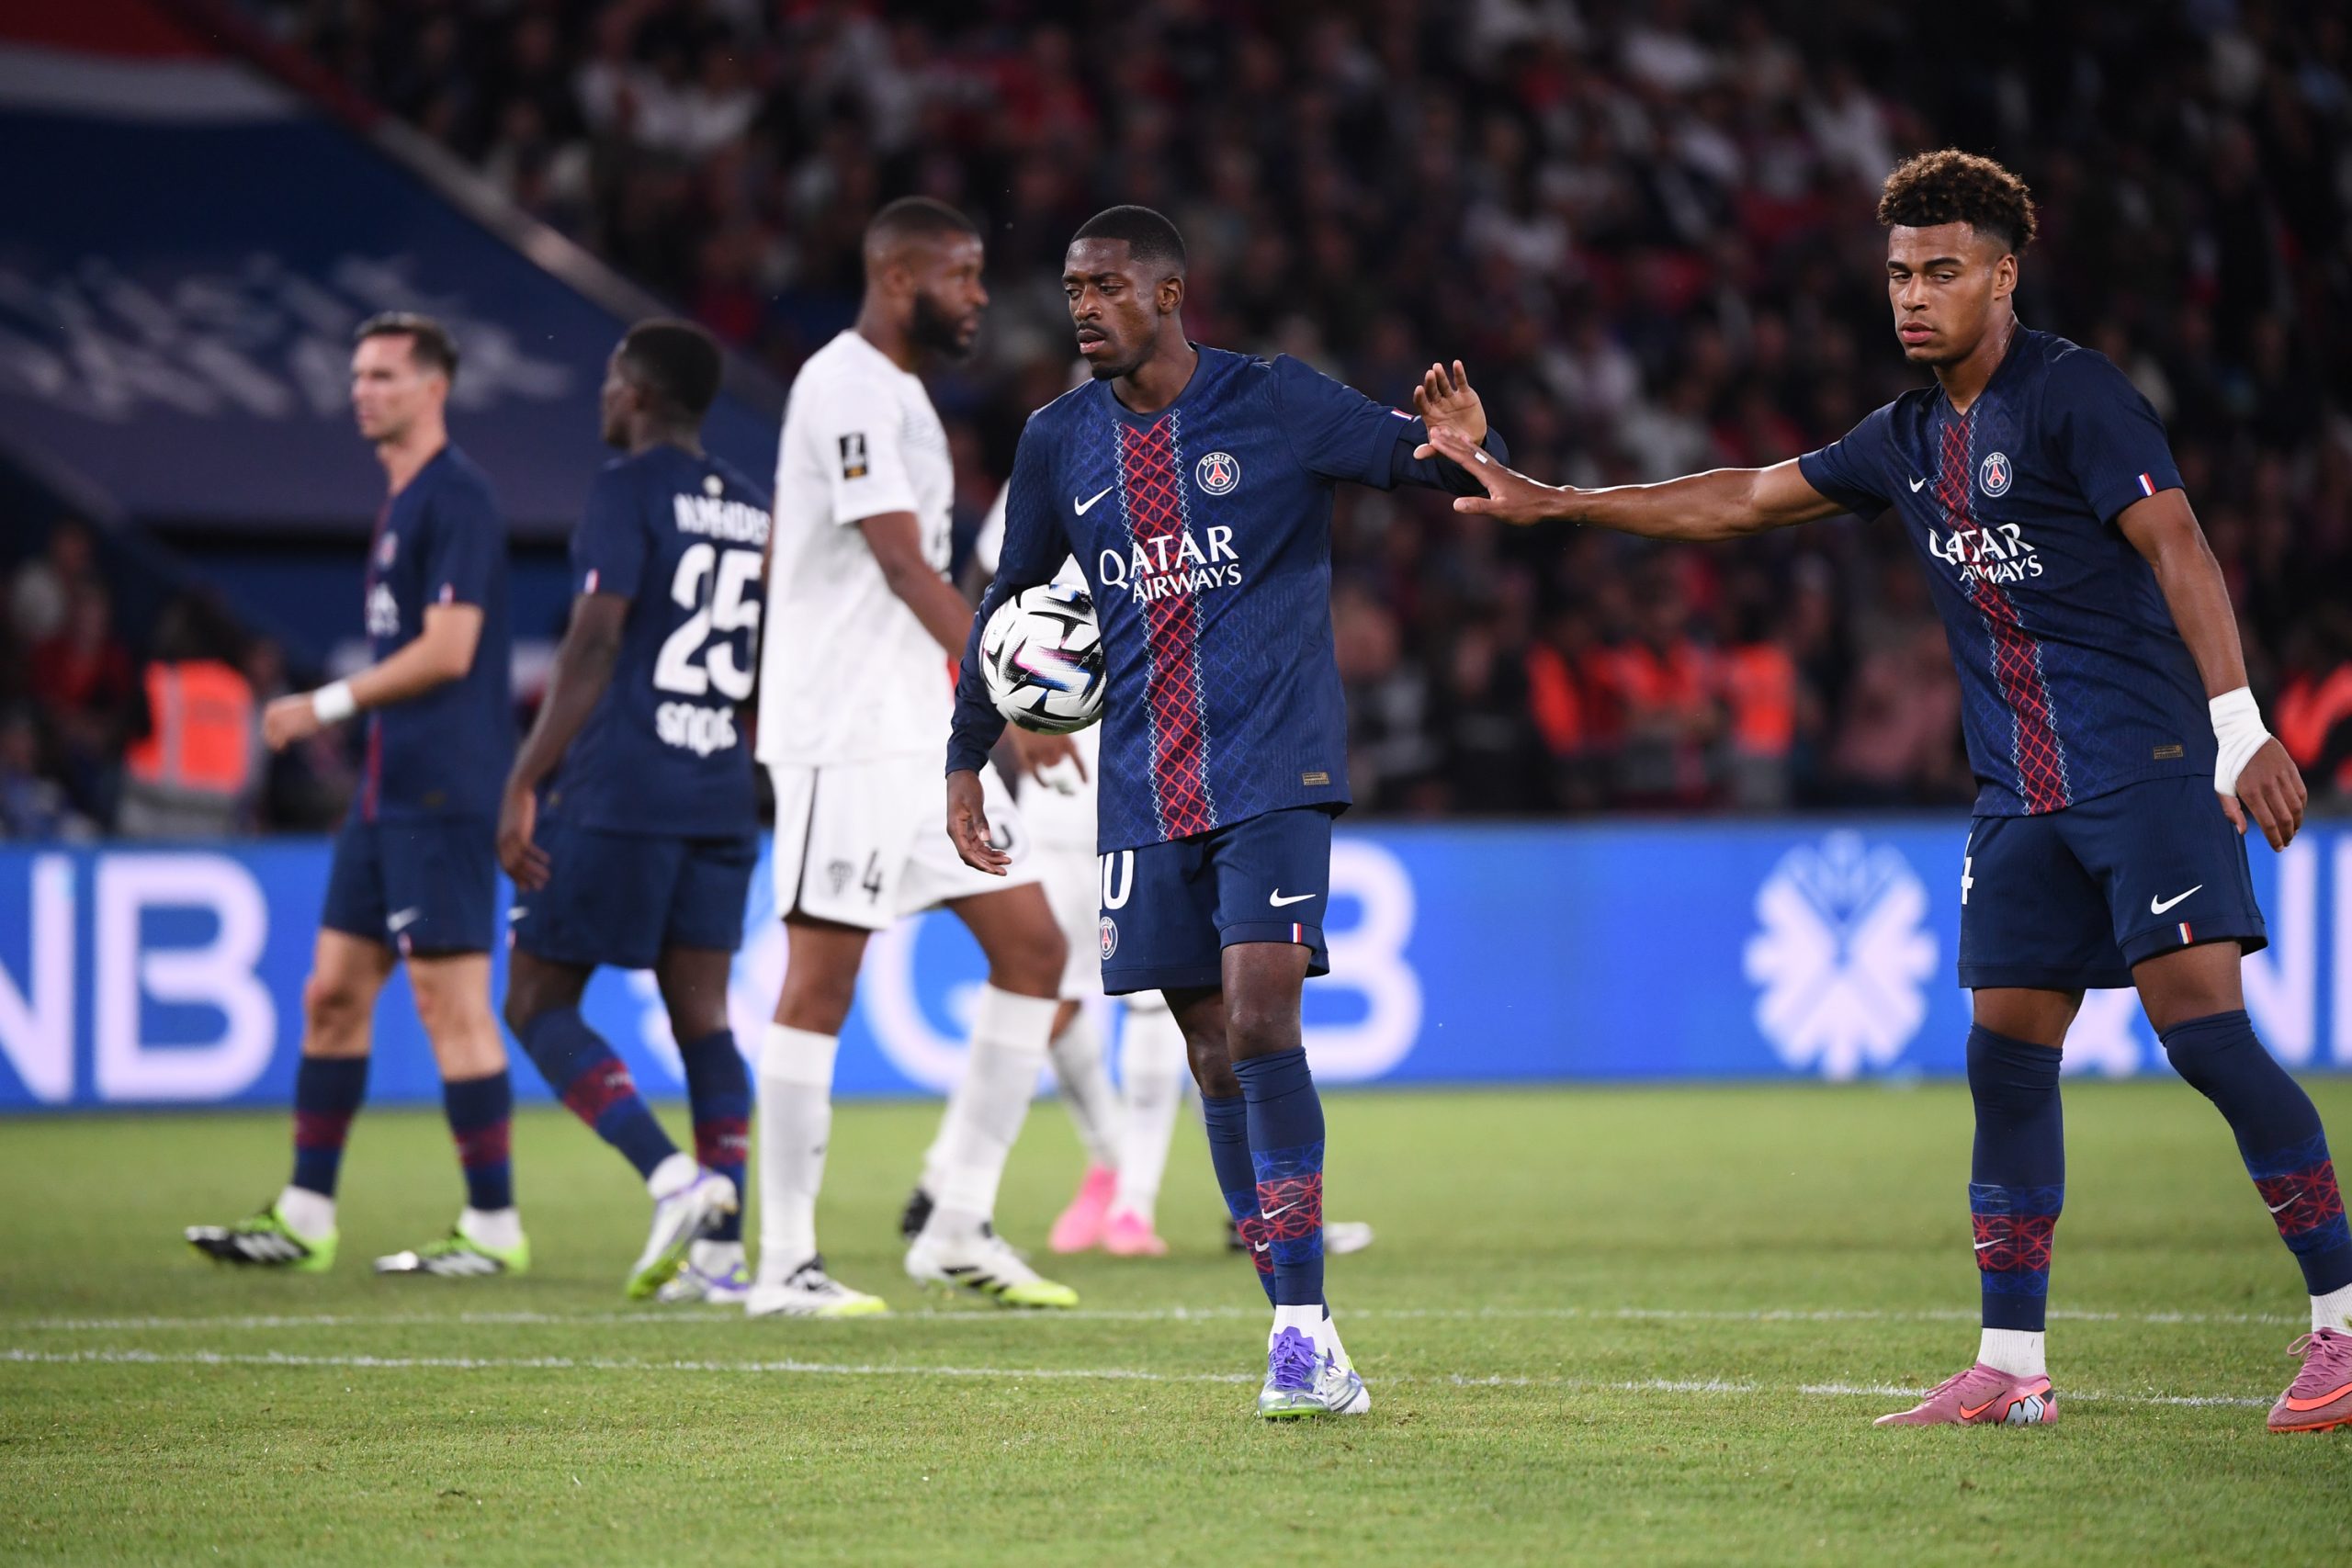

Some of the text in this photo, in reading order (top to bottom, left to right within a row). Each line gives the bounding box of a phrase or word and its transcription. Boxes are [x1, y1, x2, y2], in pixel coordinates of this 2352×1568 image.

[1202, 454, 1231, 467] PARIS
[1099, 525, 1239, 590] QATAR
[1928, 523, 2036, 566] QATAR
[1133, 563, 1242, 604] AIRWAYS
[1959, 555, 2043, 584] AWAYS
[653, 542, 764, 701] 25
[863, 849, 883, 905] 4
